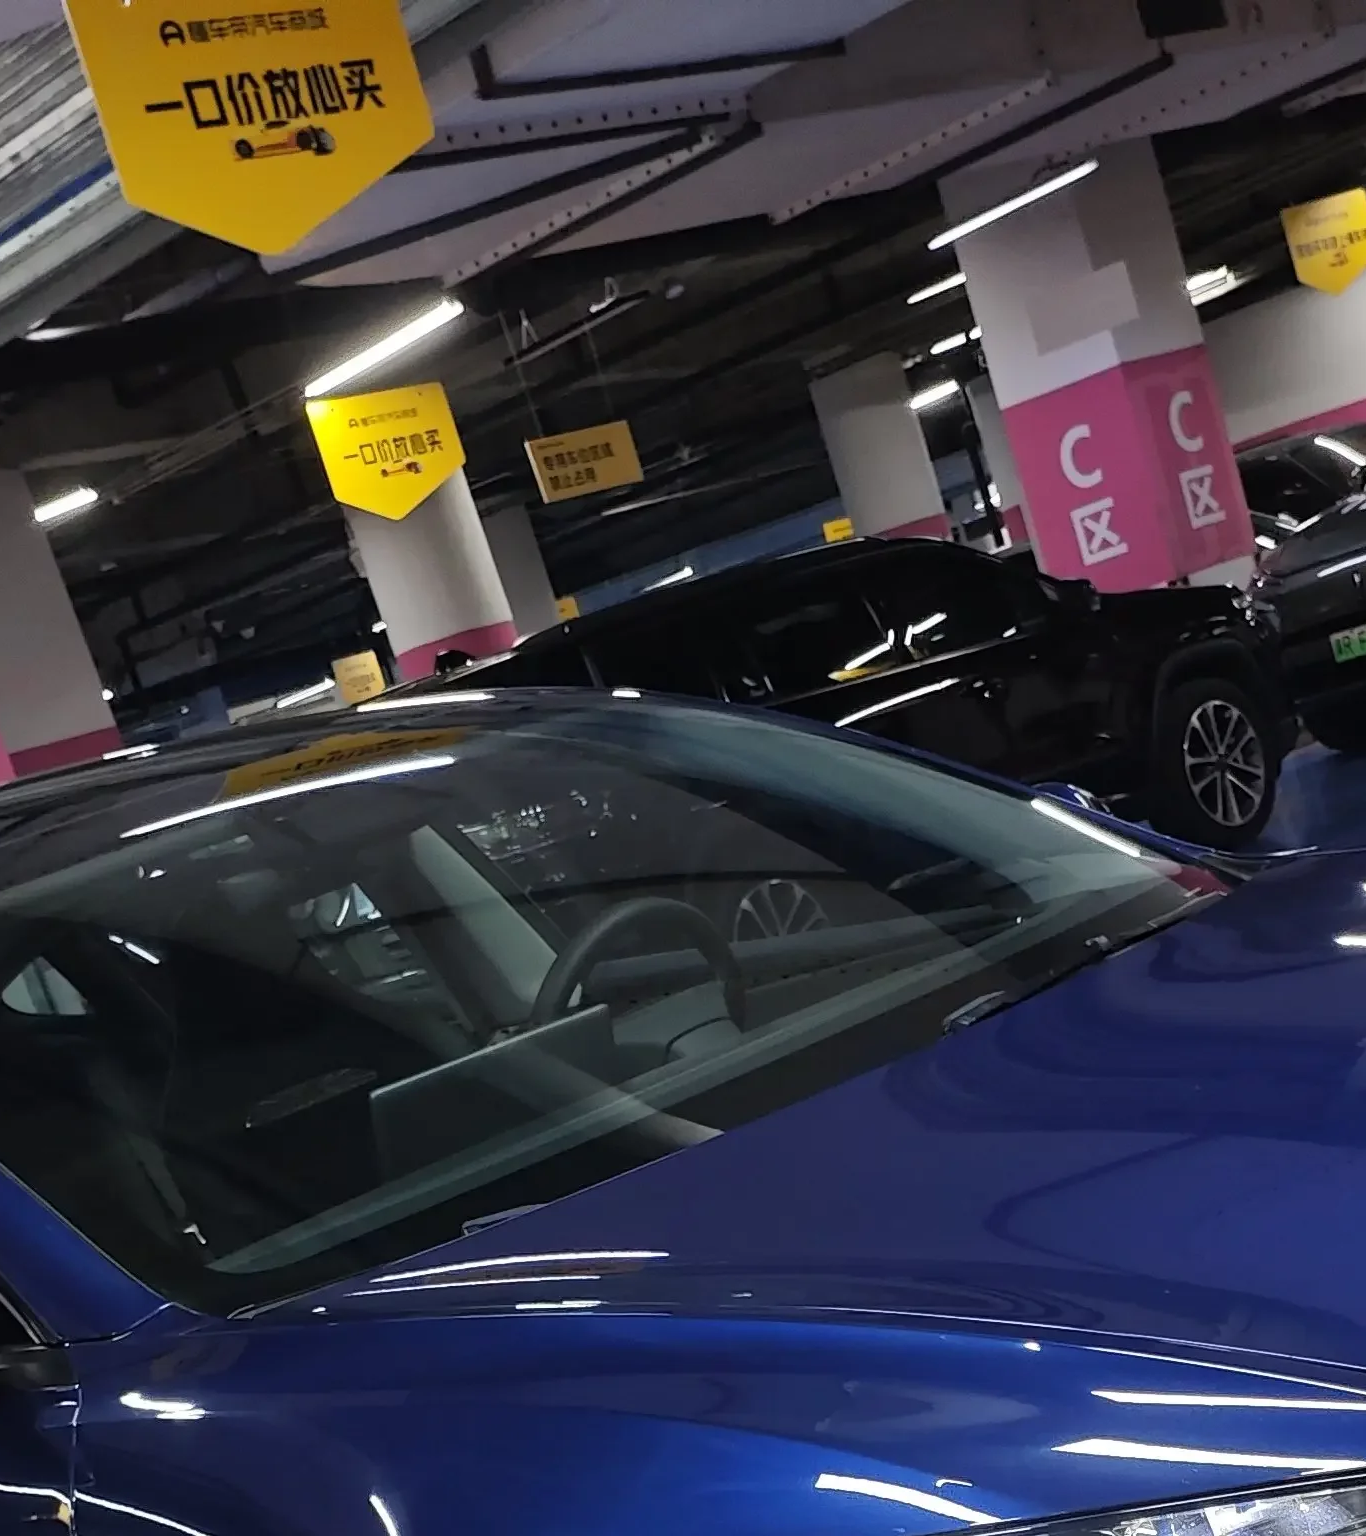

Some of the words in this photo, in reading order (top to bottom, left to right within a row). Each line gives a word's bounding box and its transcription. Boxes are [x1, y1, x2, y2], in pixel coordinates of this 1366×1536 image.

[145, 58, 385, 129] 一口价放心买
[344, 429, 443, 465] 一口价放心买
